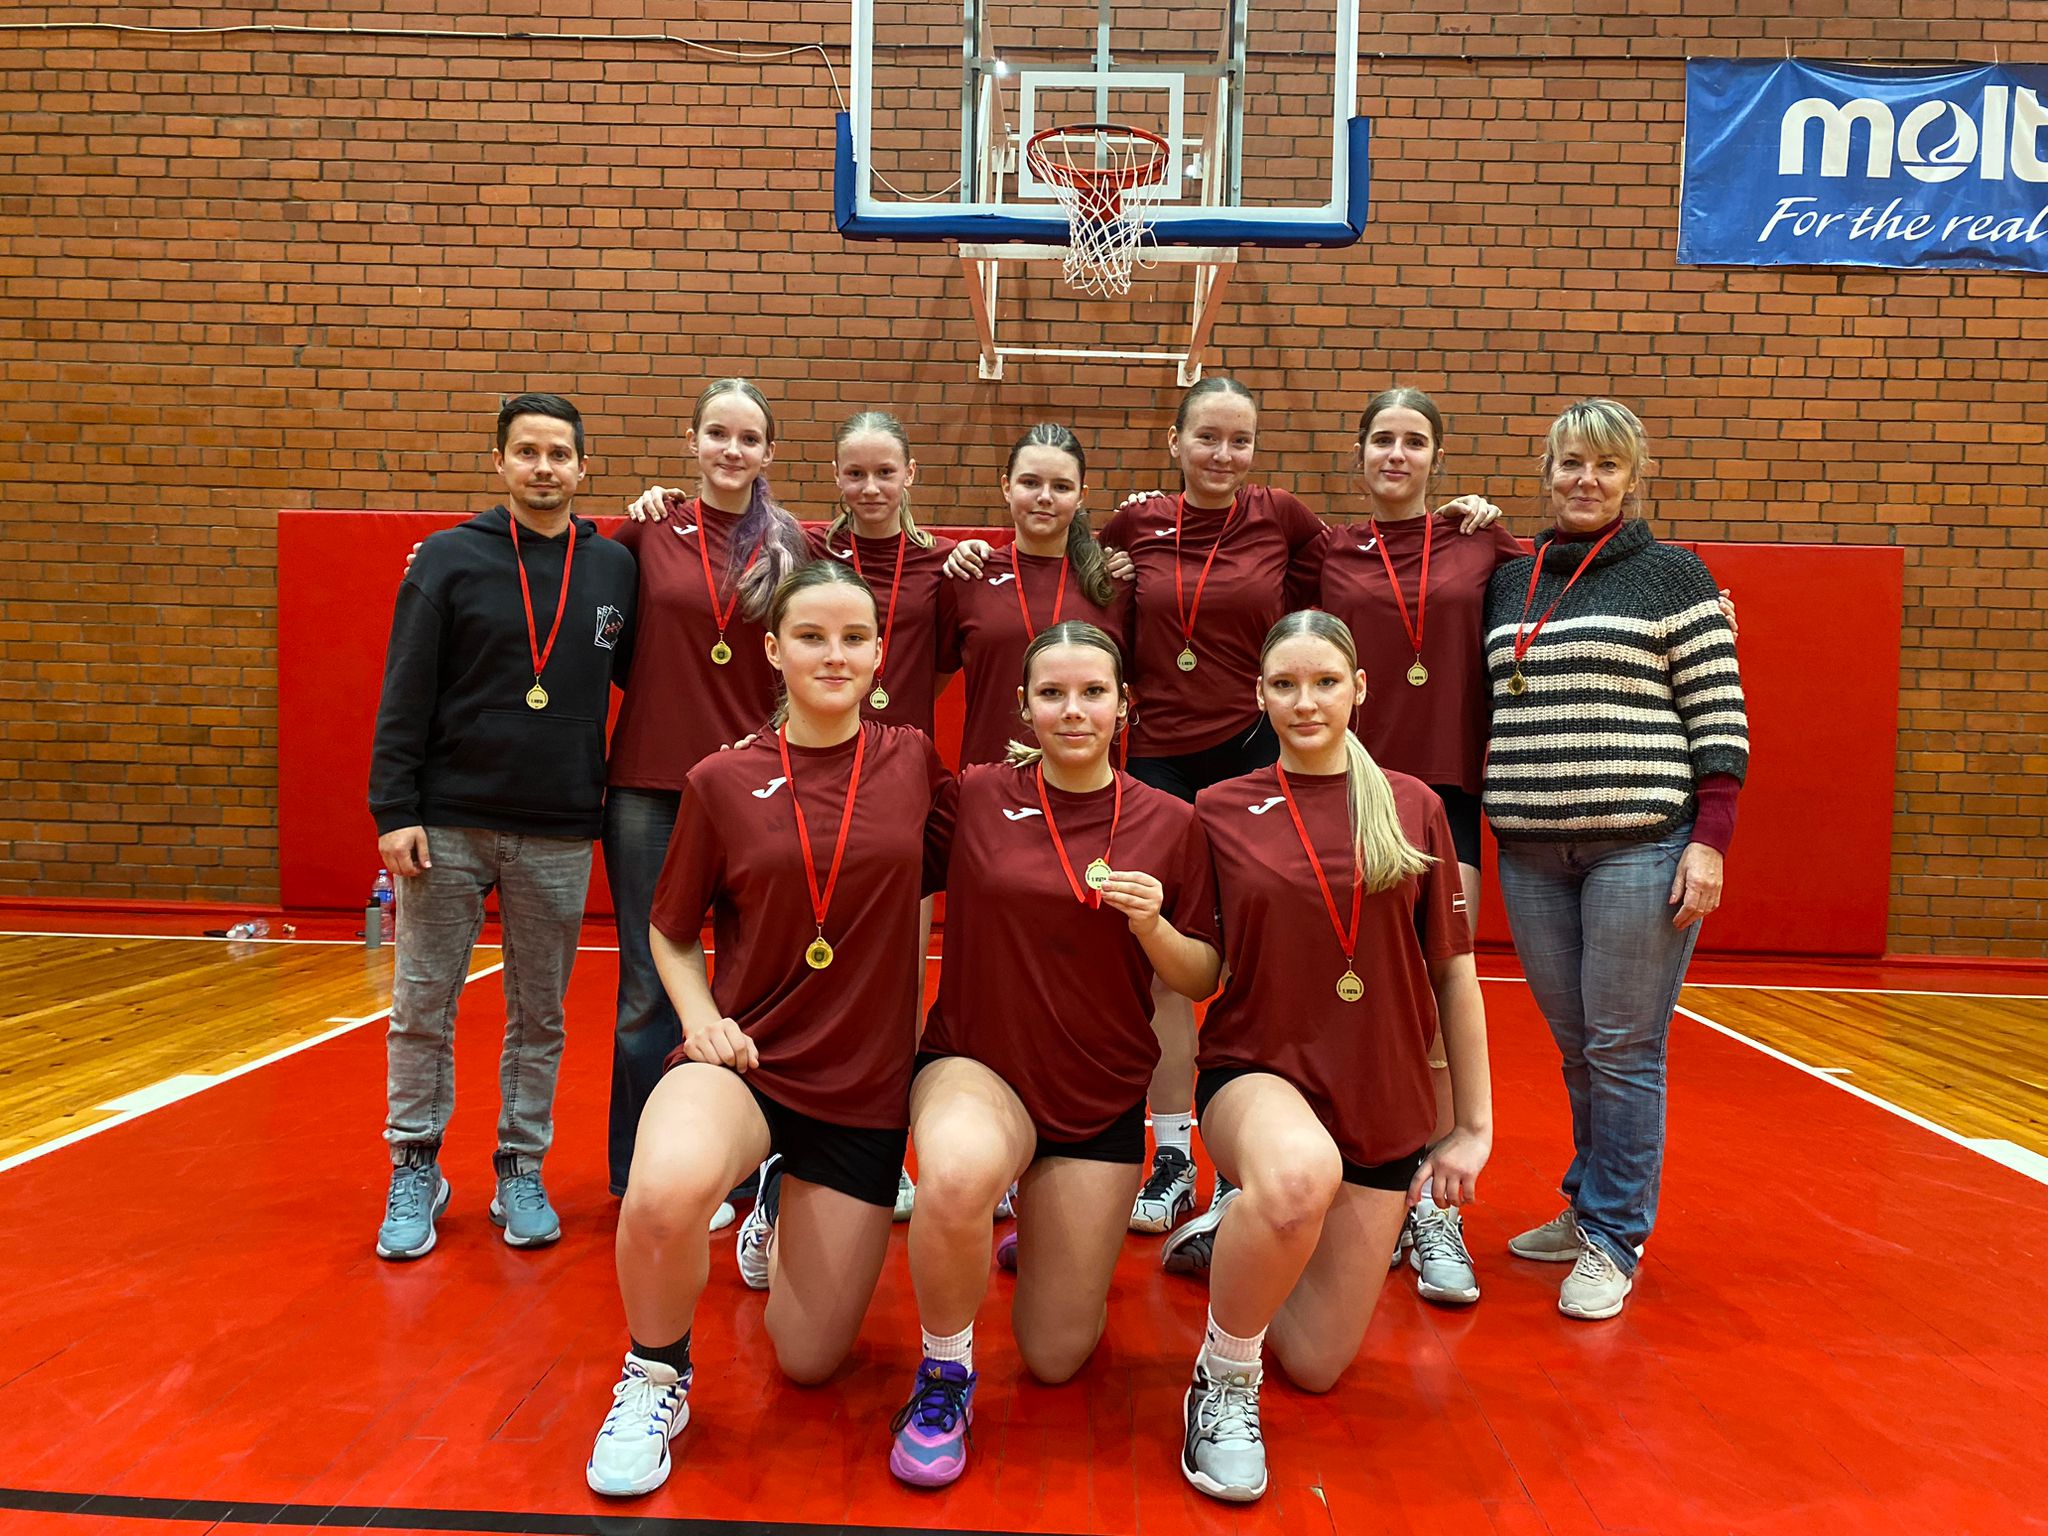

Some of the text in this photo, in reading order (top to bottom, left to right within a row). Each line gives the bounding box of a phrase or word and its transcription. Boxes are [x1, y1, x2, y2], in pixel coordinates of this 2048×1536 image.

[1757, 196, 2048, 243] For the real
